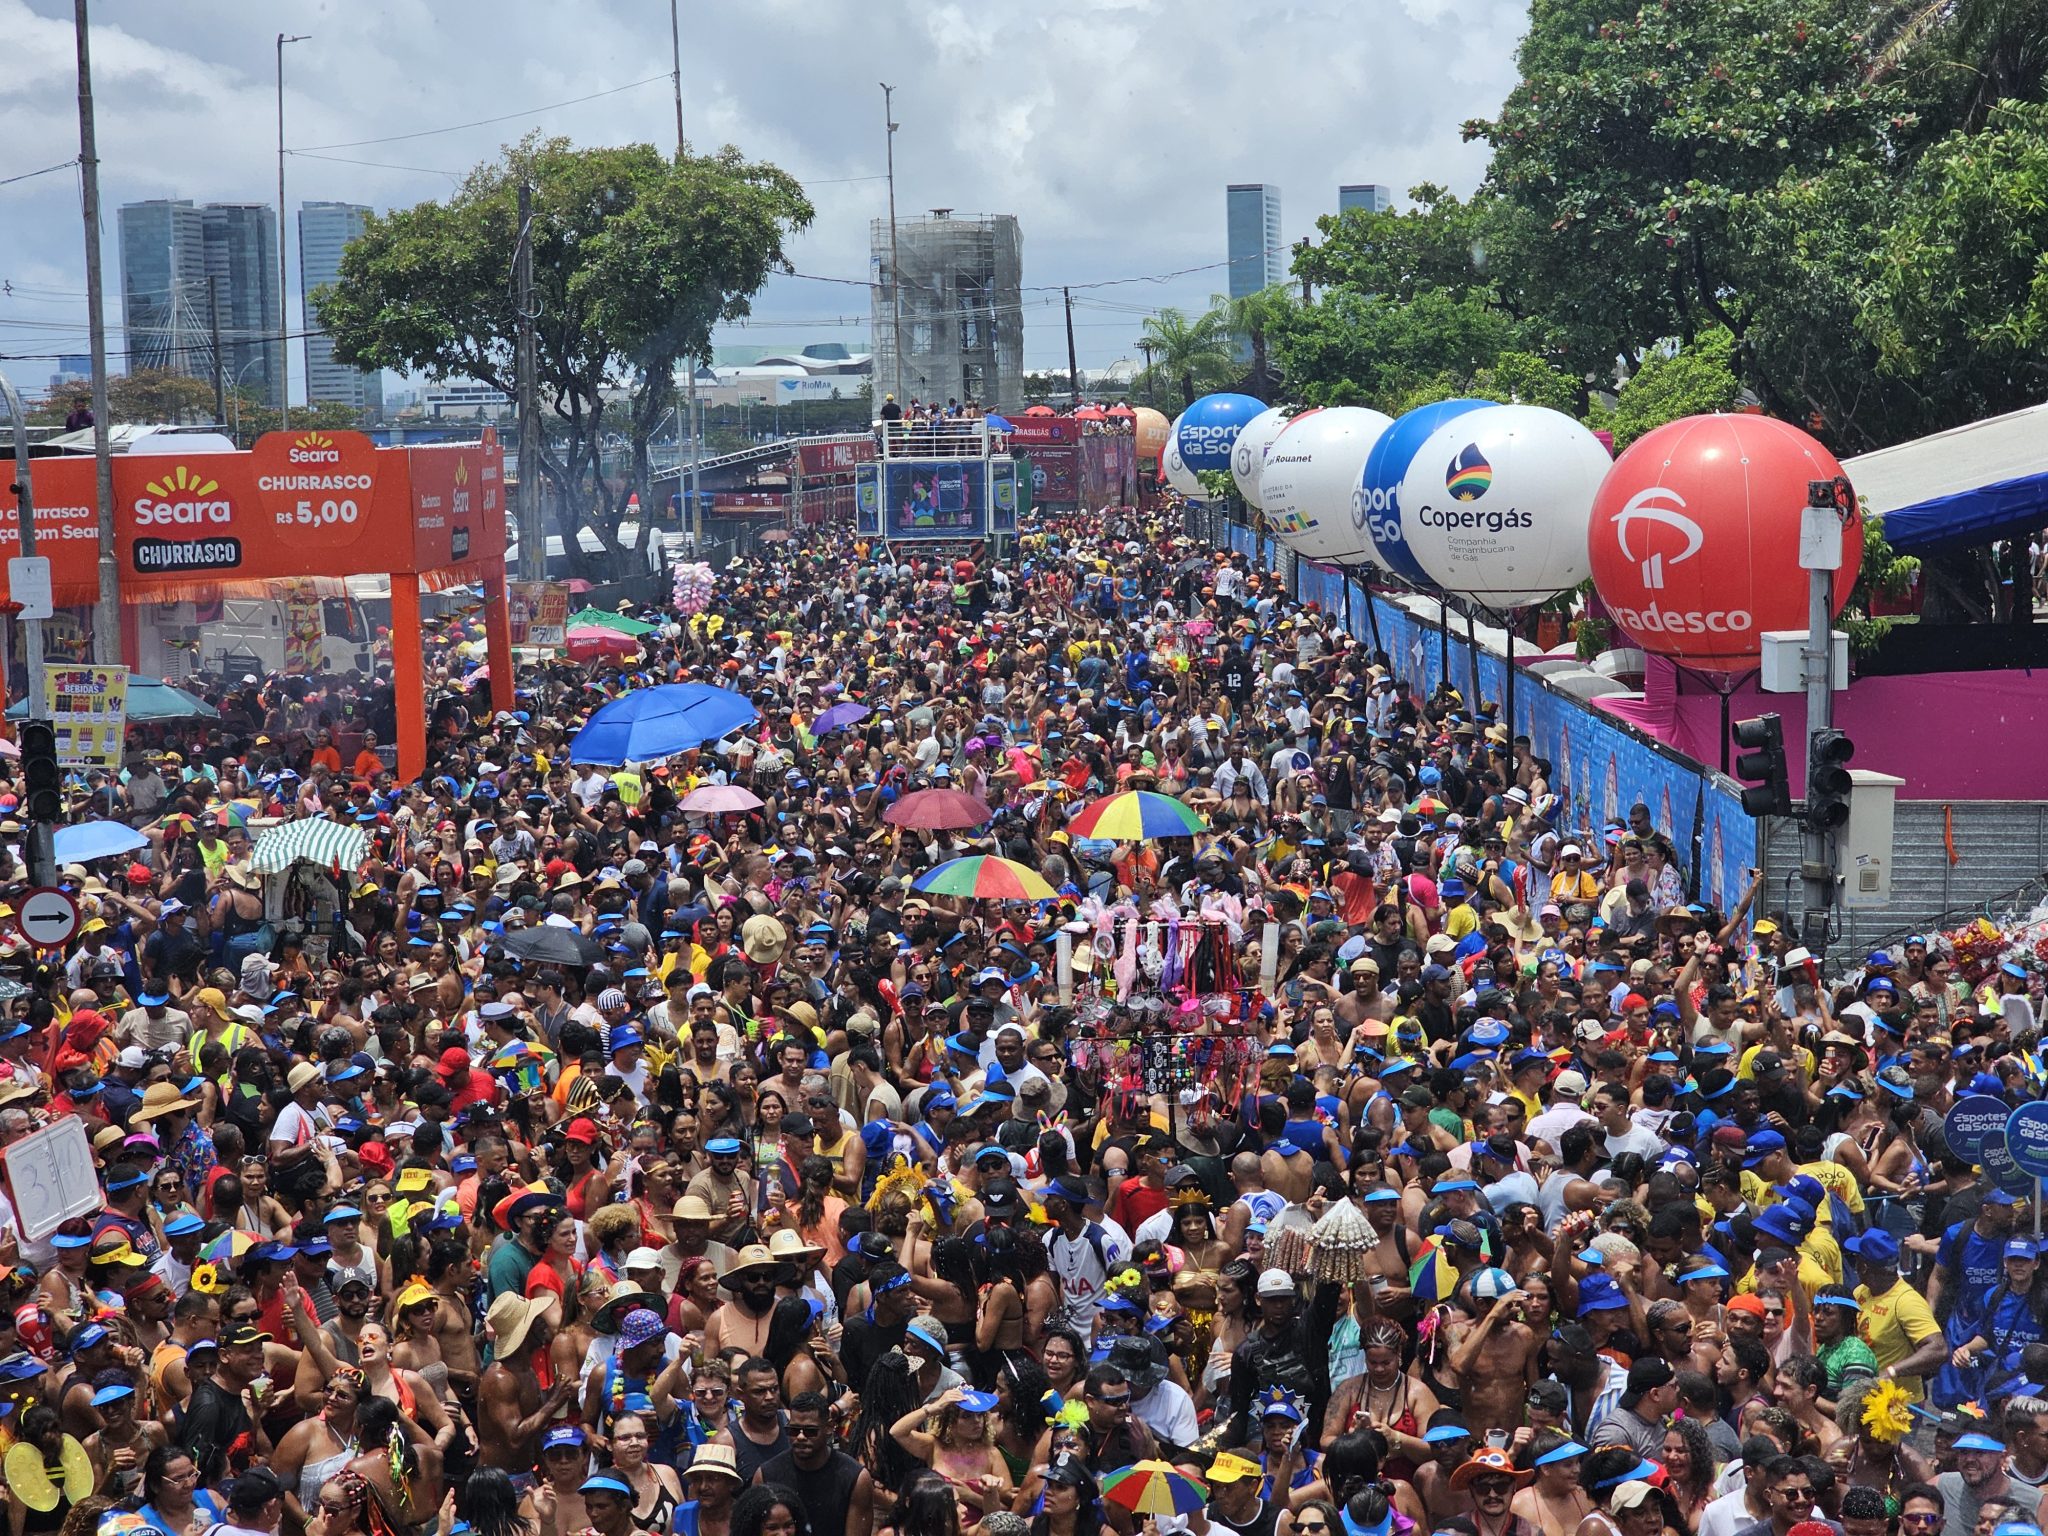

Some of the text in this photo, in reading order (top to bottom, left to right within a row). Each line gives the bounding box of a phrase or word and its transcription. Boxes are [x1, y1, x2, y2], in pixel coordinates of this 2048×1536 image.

[1180, 424, 1241, 440] Esport
[289, 448, 339, 463] Seara
[1275, 454, 1312, 463] Rouanet
[258, 475, 371, 490] CHURRASCO
[135, 498, 230, 525] Seara
[276, 499, 358, 528] R$ 5,00
[1419, 506, 1533, 532] Copergás
[1447, 536, 1497, 546] Companhia
[138, 543, 236, 565] CHURRASCO
[1448, 544, 1515, 554] Pernambucana
[1601, 594, 1752, 634] bradesco
[1227, 674, 1241, 688] 12
[64, 685, 99, 694] BEBIDAS
[1953, 1112, 2007, 1124] Esportes
[2018, 1116, 2048, 1131] Espo
